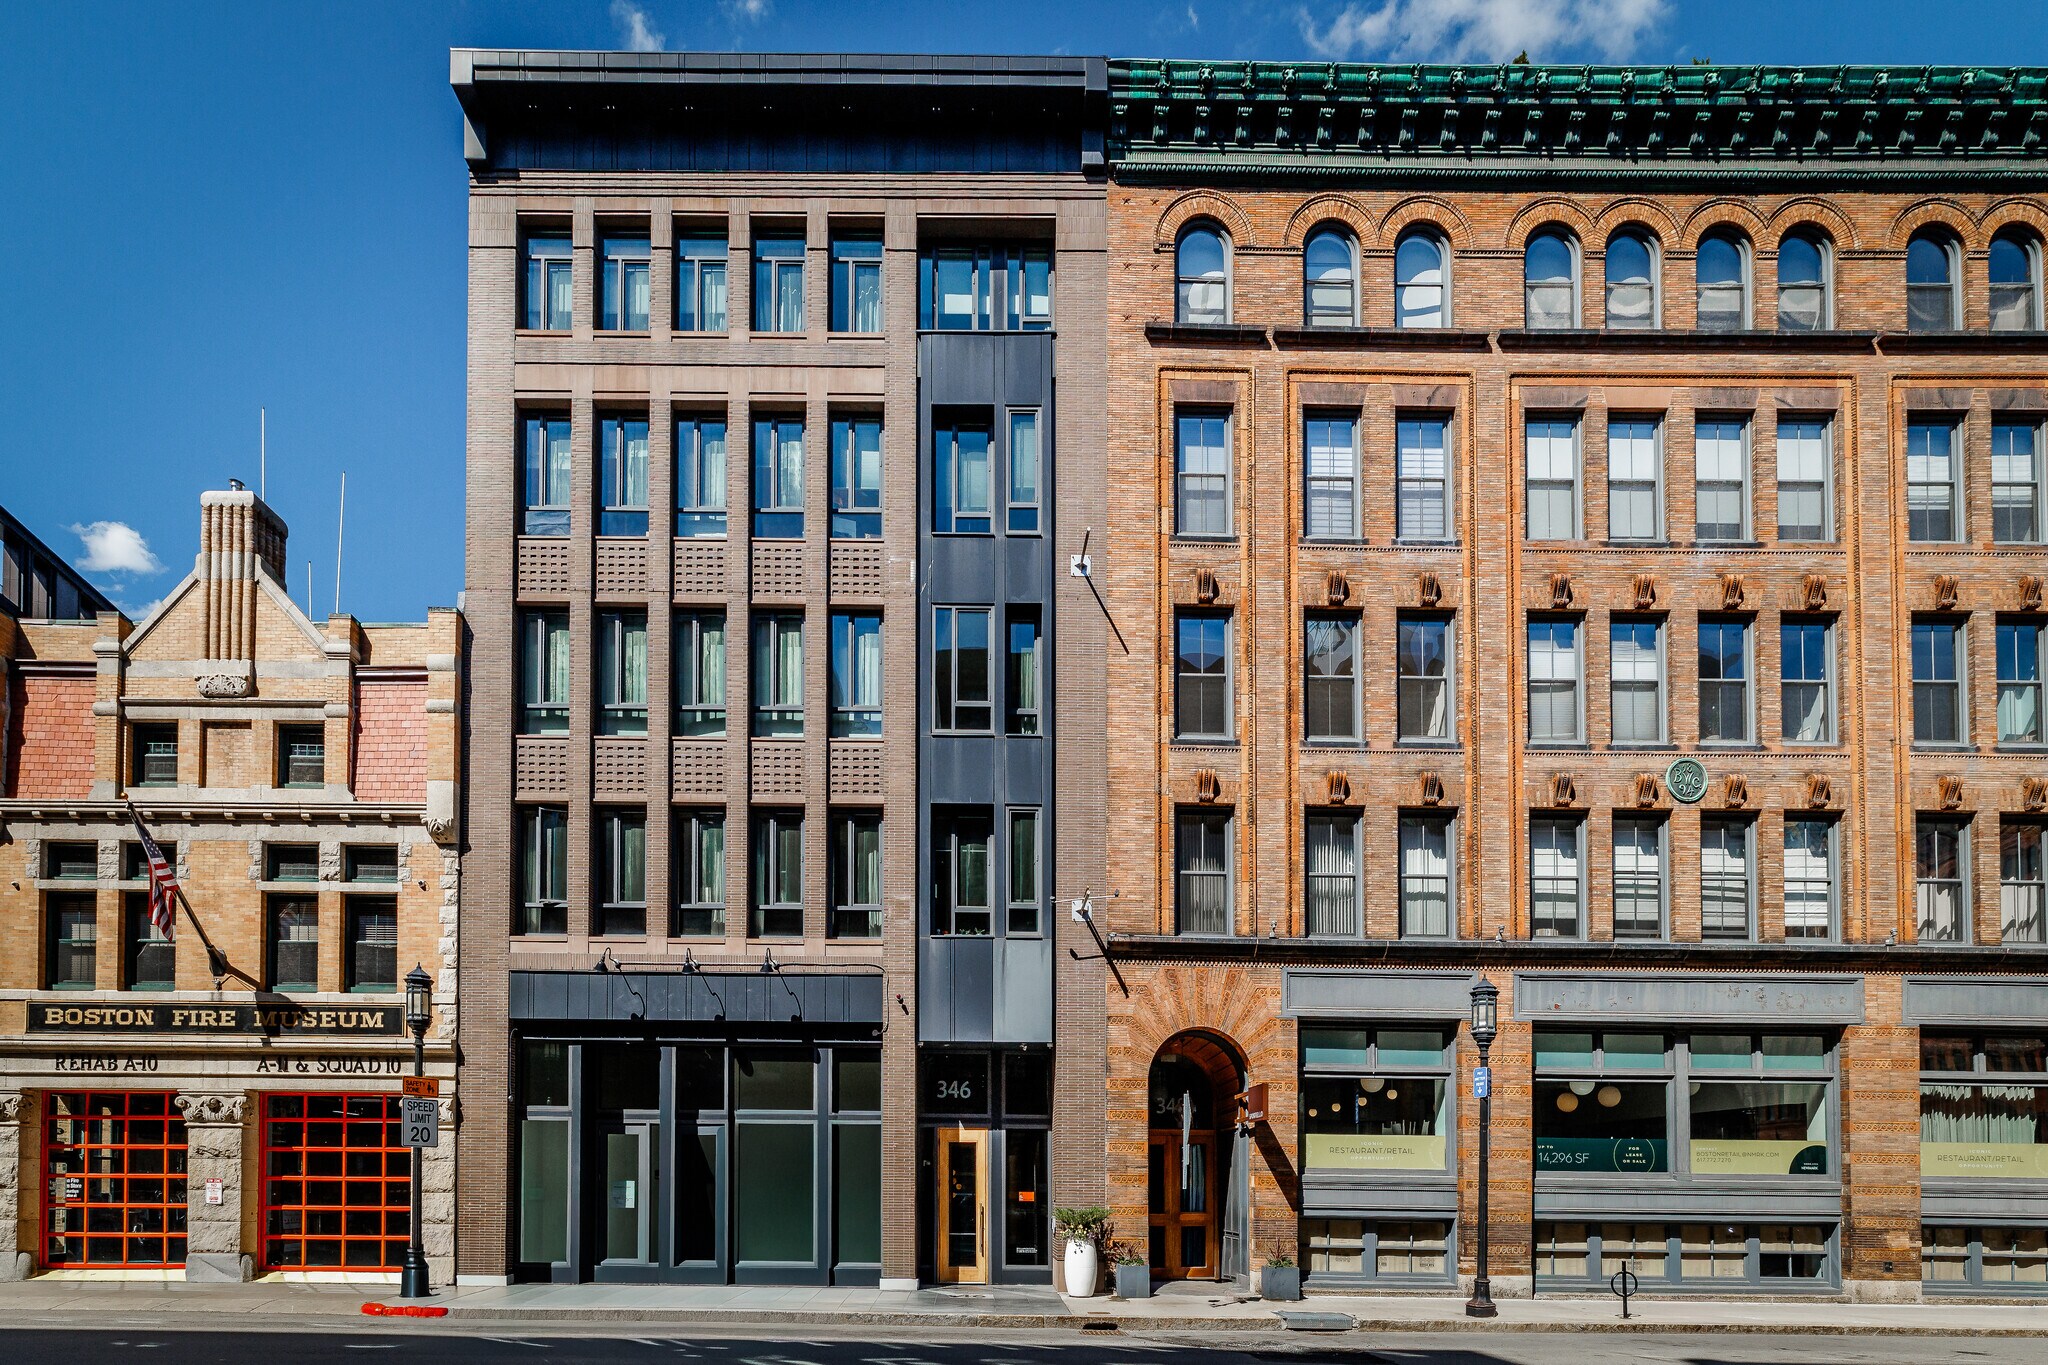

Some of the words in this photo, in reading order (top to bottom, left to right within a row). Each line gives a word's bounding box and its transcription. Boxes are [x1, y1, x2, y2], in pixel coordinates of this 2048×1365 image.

[44, 1008, 155, 1026] BOSTON
[172, 1009, 236, 1027] FIRE
[253, 1010, 385, 1028] MUSEUM
[54, 1054, 119, 1072] REHAB
[123, 1054, 159, 1072] A-10
[295, 1057, 310, 1073] &
[317, 1056, 382, 1074] SQUAD
[386, 1057, 402, 1074] 10
[405, 1080, 426, 1088] SAFETY
[936, 1080, 971, 1099] 346
[407, 1100, 435, 1112] SPEED
[410, 1113, 432, 1124] LIMIT
[410, 1126, 431, 1143] 20
[1329, 1146, 1416, 1155] RESTAURANT/RETAIL
[1538, 1152, 1573, 1164] 14,296
[1575, 1152, 1590, 1164] SF
[1937, 1154, 2025, 1163] RESTAURANT/RETAIL
